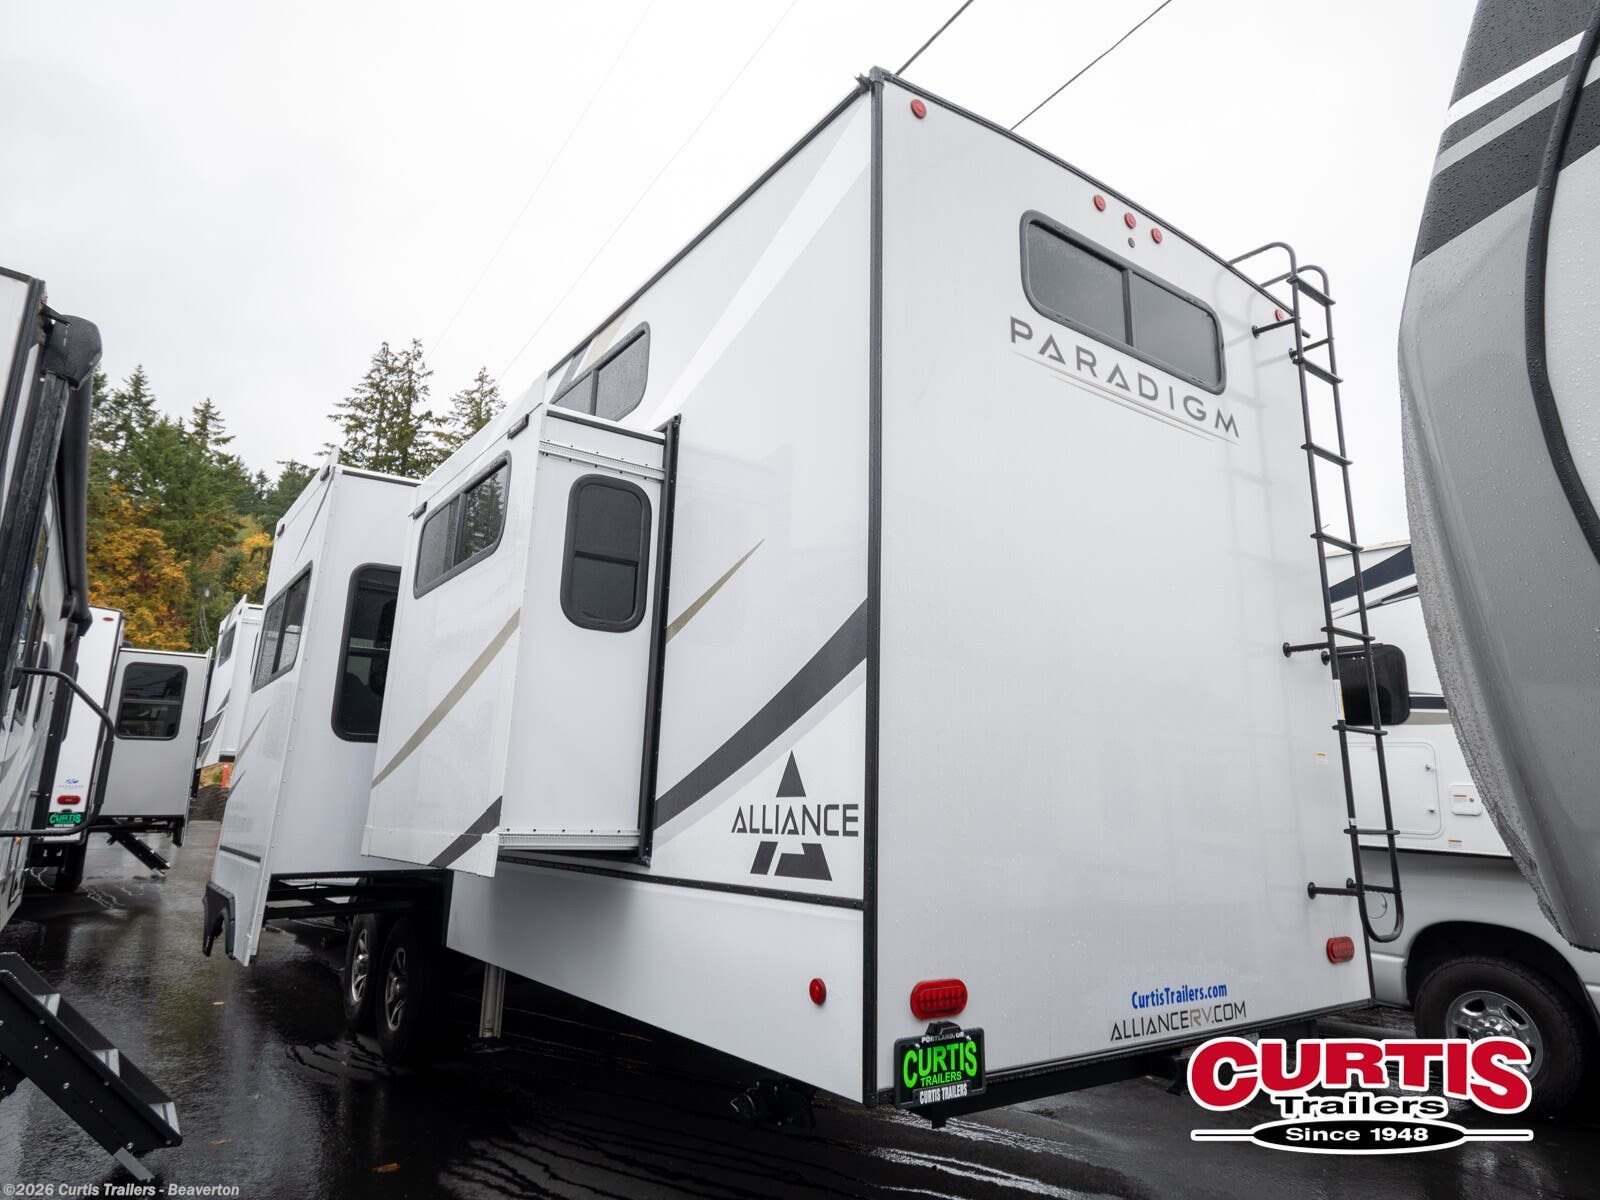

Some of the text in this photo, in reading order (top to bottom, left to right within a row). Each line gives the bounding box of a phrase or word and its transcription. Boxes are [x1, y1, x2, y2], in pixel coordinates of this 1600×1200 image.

[1009, 316, 1240, 438] PARADIGM
[49, 813, 81, 825] CURTIS
[731, 803, 859, 837] ALLIANCE
[1131, 983, 1227, 1009] CurtisTrailers.com
[1110, 1000, 1246, 1041] ALLIANCERV.COM
[903, 1041, 977, 1088] CURTIS
[920, 1071, 962, 1087] TRAILERS
[919, 1083, 968, 1104] CURTIS TRAILERS
